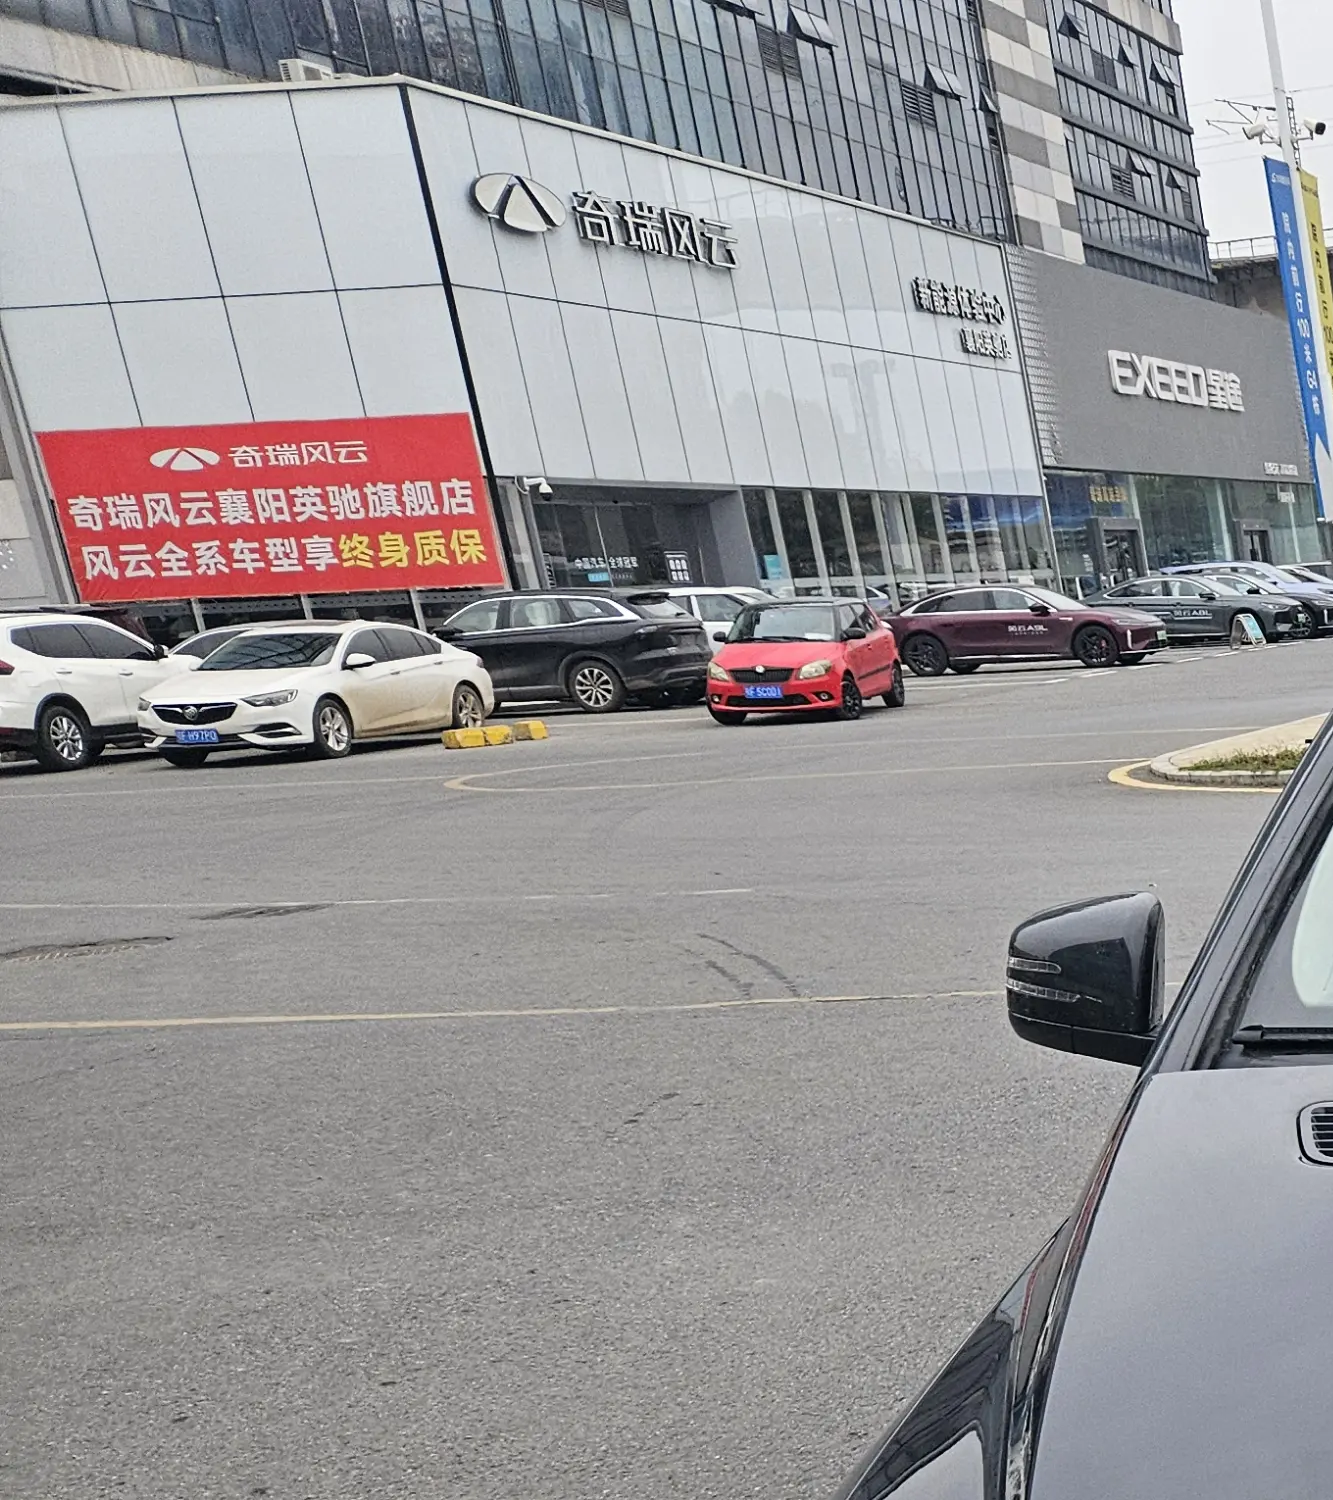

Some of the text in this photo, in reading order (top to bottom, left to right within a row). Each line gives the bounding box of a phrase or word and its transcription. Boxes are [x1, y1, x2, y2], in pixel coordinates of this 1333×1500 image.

[571, 189, 740, 270] 奇瑞风云
[228, 440, 368, 468] 奇瑞风云
[67, 477, 476, 531] 奇瑞风云襄阳英驰旗舰店
[81, 528, 487, 580] 风云全系车型享终身质保
